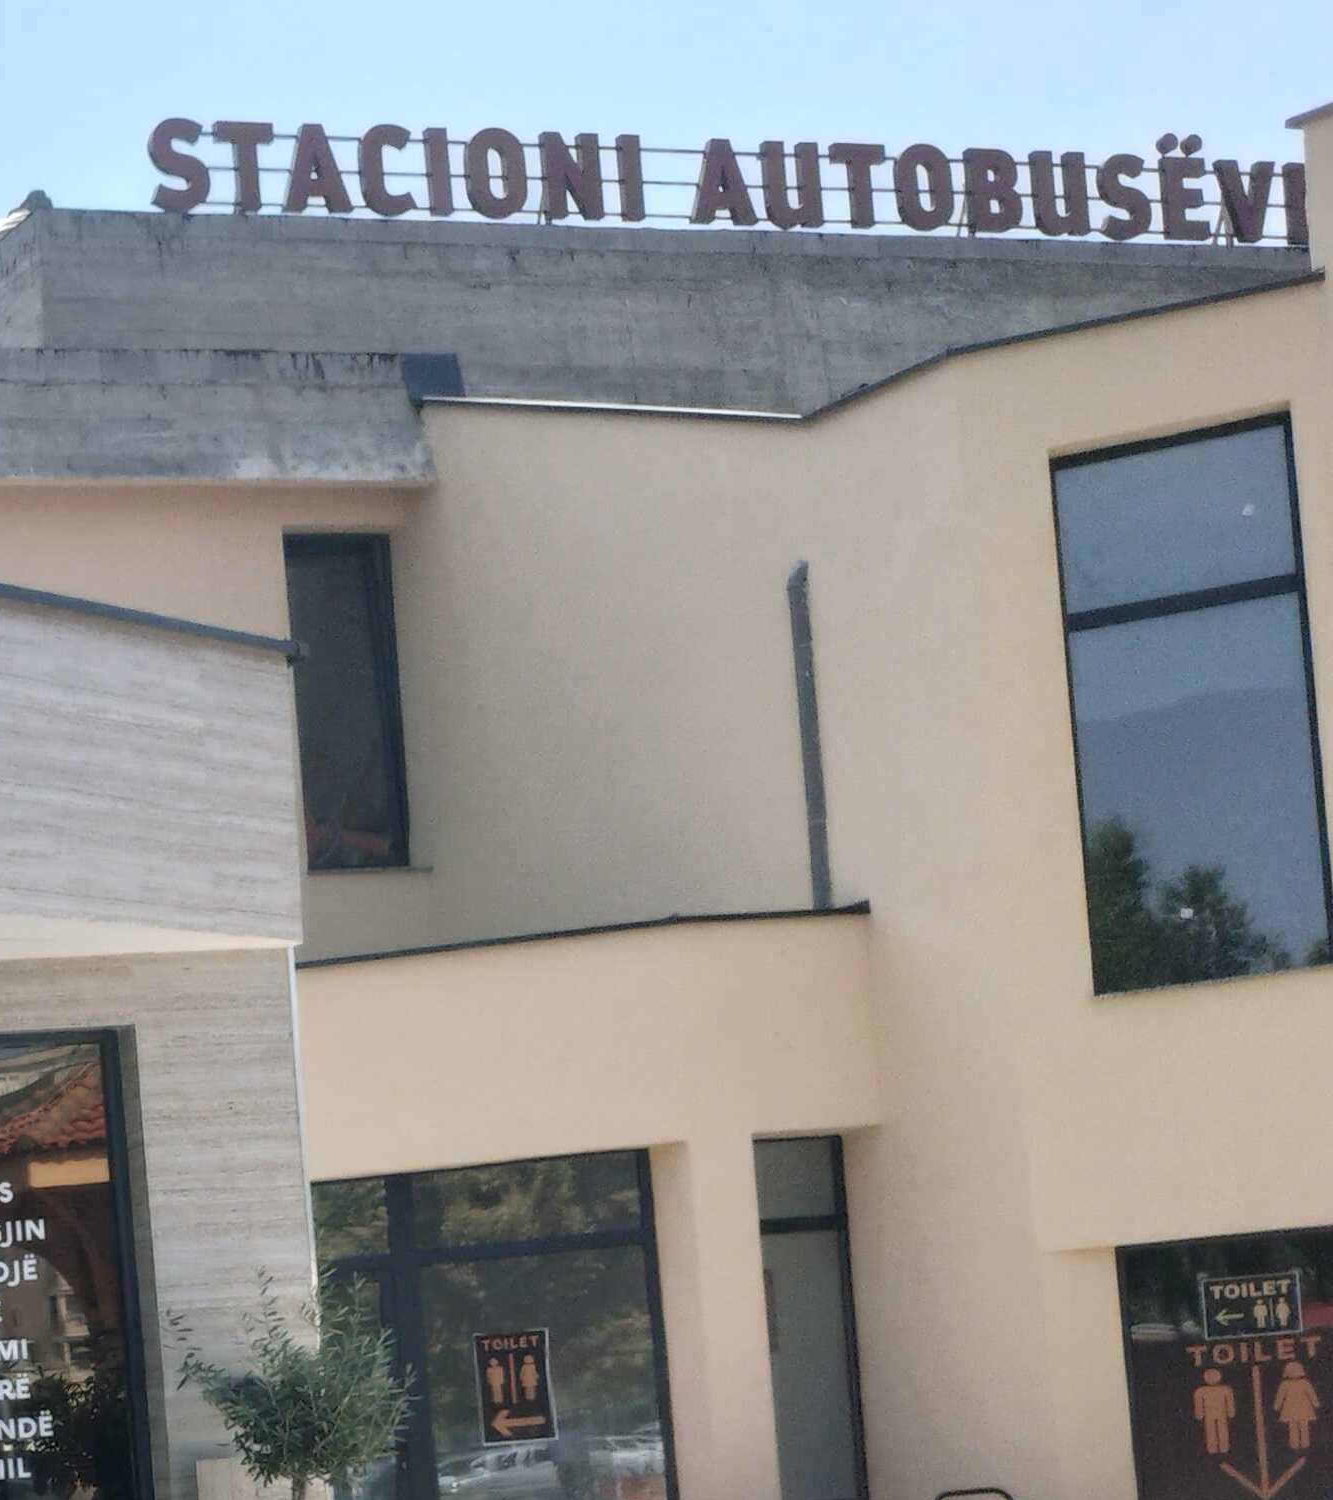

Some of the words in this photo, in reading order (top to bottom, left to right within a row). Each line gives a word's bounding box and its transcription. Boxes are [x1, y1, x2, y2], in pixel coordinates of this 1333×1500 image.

[148, 116, 645, 223] STACIONI
[695, 132, 1309, 245] AUTOBUSËVI
[1209, 1279, 1291, 1299] TOILET
[481, 1335, 539, 1351] TOILET
[1186, 1336, 1321, 1367] TOILET
